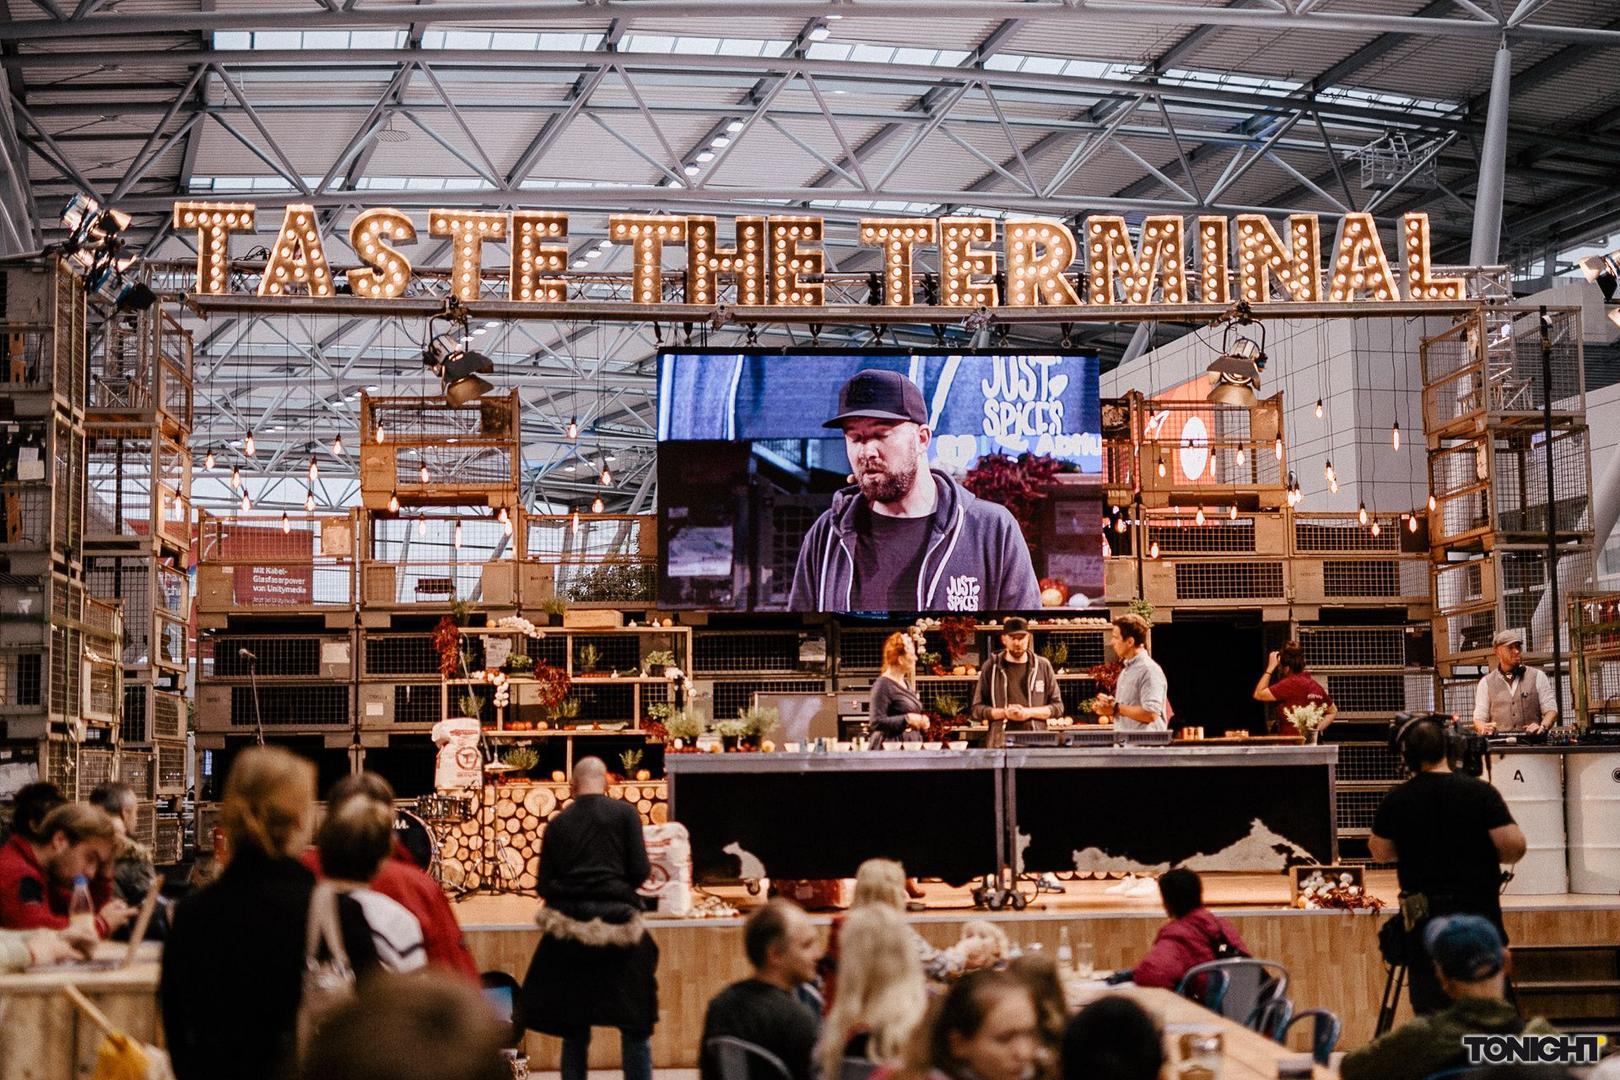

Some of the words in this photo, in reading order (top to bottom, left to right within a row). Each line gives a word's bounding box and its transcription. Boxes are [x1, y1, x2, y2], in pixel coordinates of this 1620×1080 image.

[174, 202, 569, 302] TASTE
[609, 214, 824, 306] THE
[859, 213, 1465, 306] TERMINAL
[981, 356, 1058, 401] JUST
[982, 400, 1064, 437] SPICES
[946, 575, 978, 596] JUST
